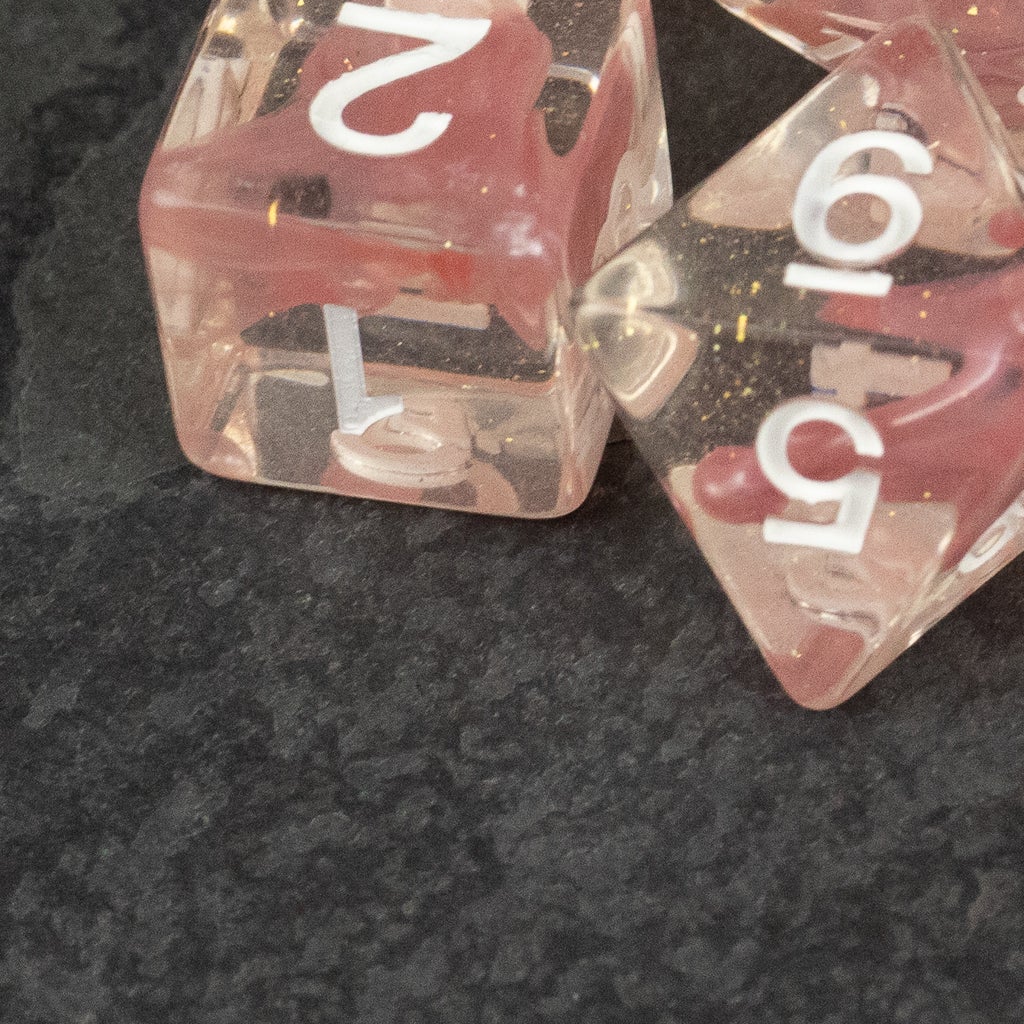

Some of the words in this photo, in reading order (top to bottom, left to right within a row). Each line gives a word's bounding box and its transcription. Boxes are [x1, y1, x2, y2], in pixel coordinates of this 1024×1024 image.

[309, 2, 492, 156] 2
[783, 130, 934, 297] 6
[322, 304, 404, 435] 1
[757, 396, 885, 554] 5
